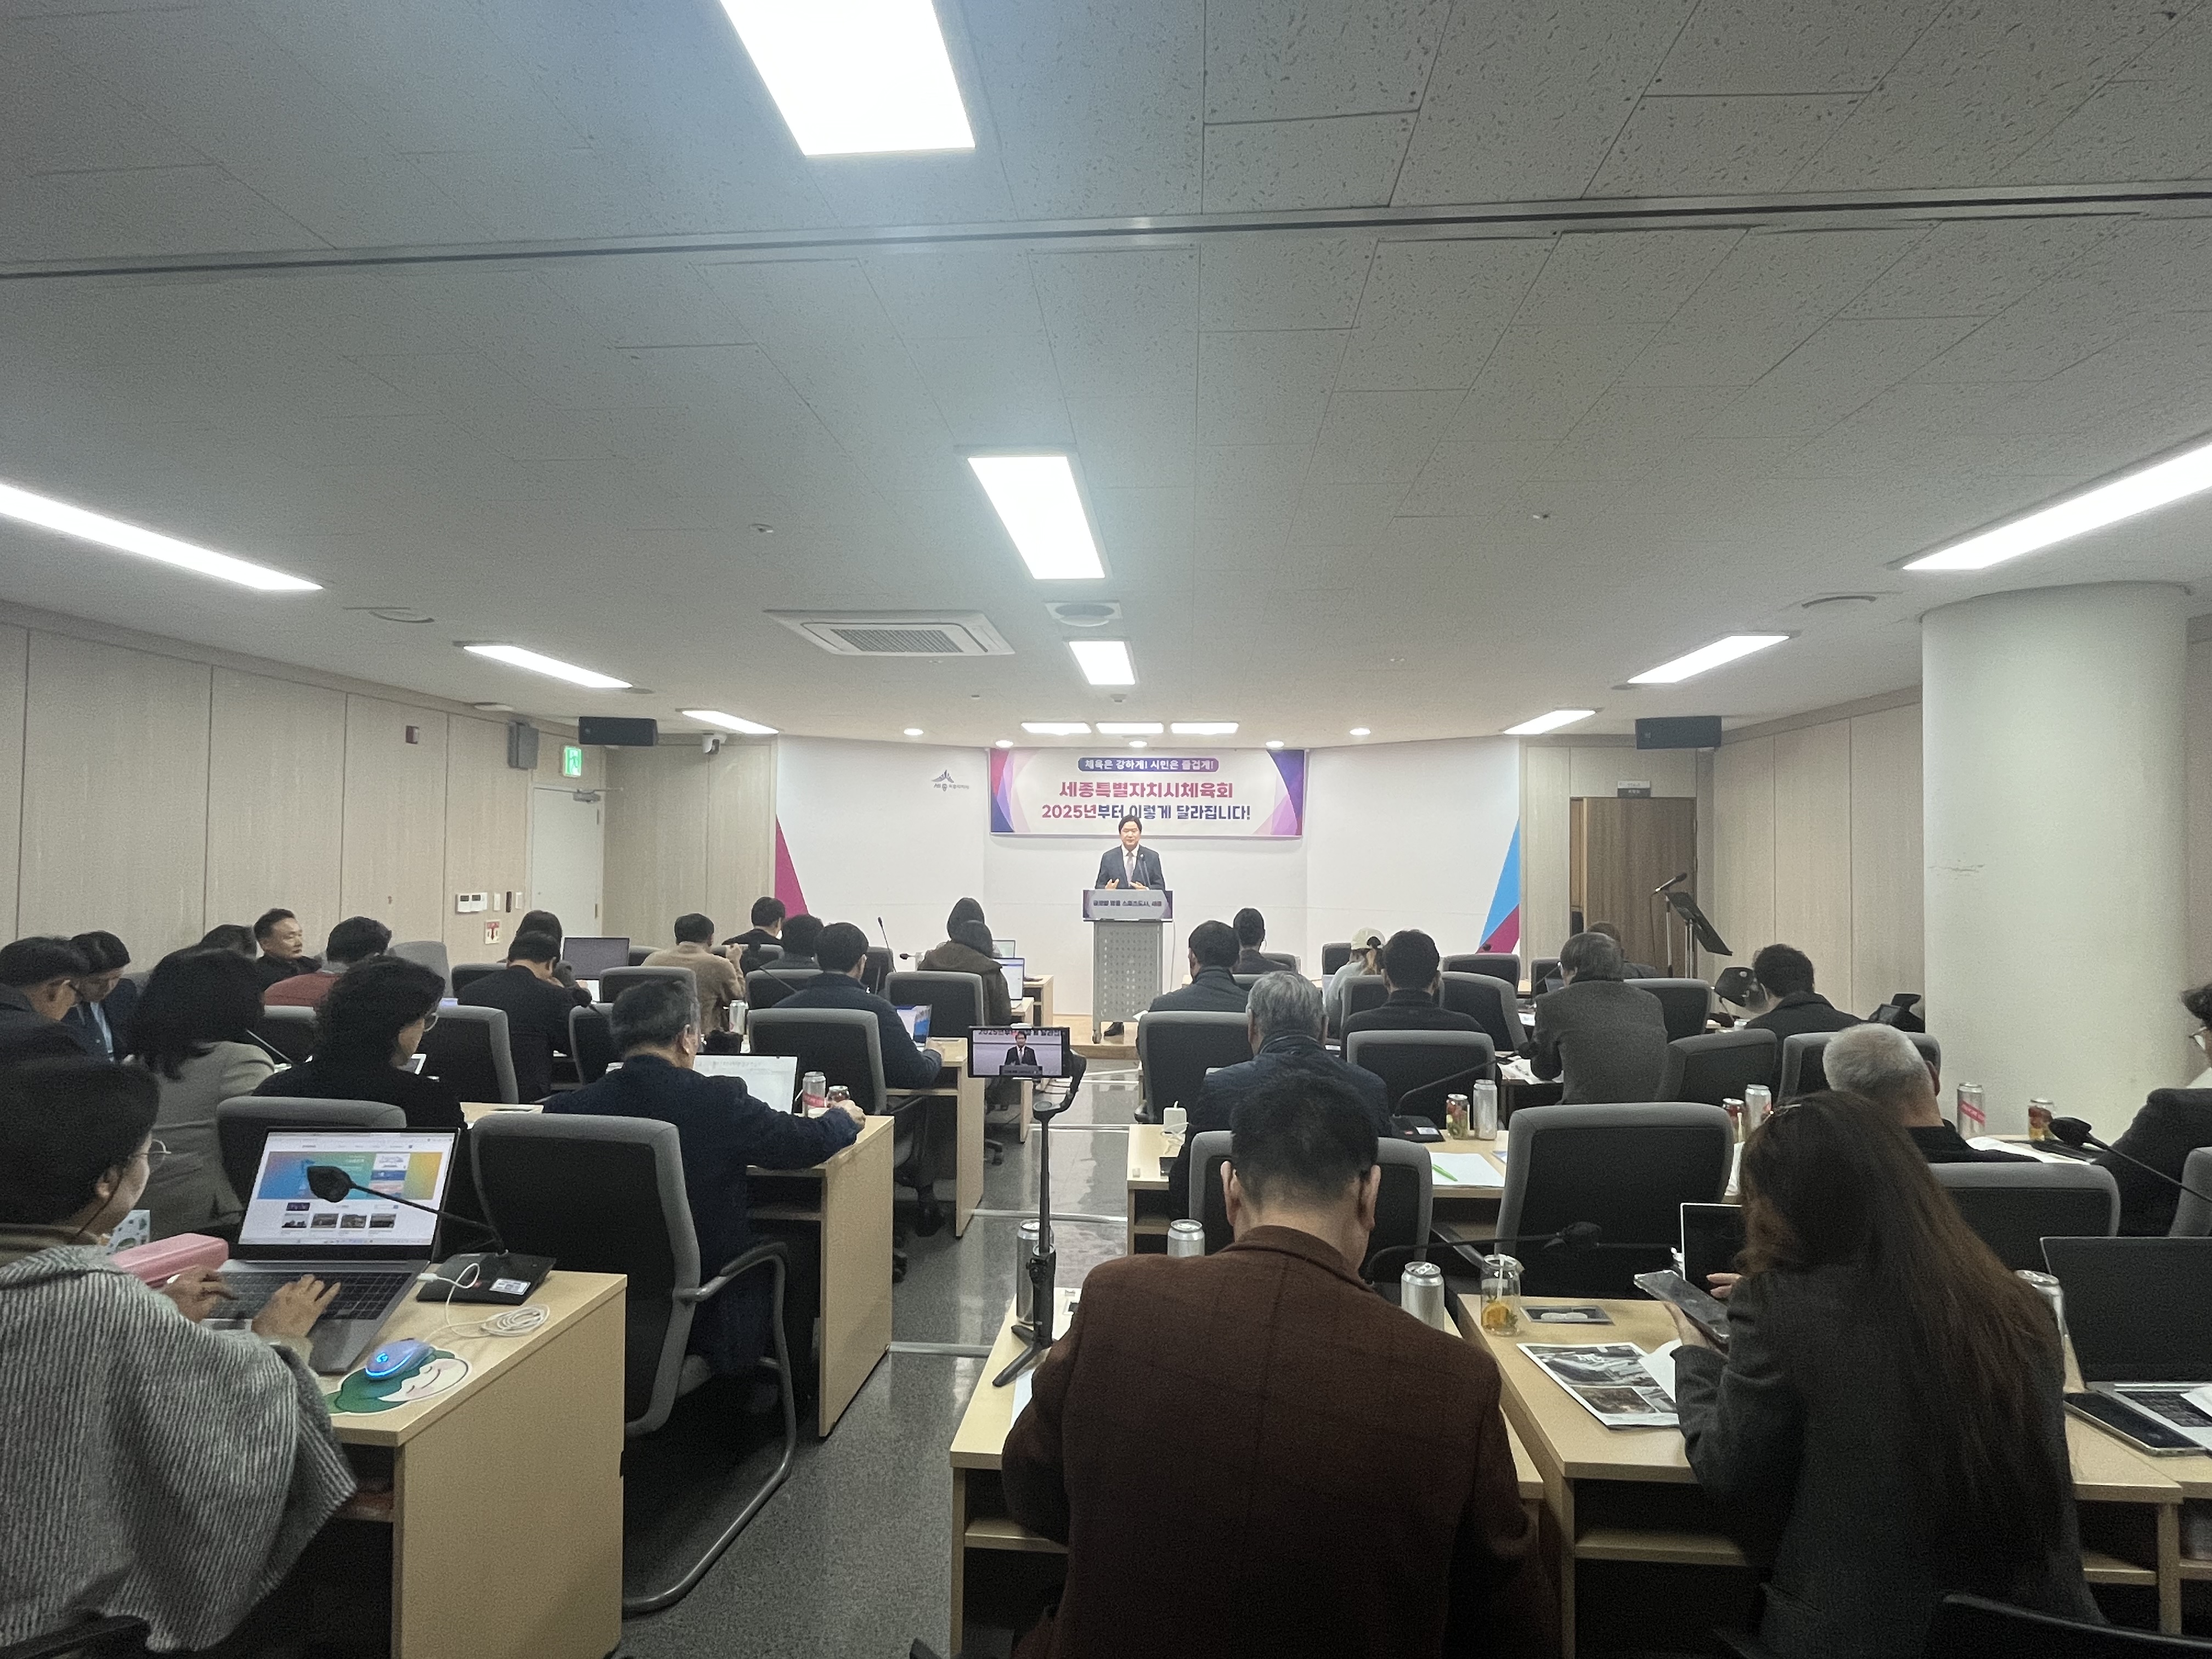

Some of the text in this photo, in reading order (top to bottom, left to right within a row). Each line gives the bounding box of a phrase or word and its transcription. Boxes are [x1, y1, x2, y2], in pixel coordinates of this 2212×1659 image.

[1085, 759, 1114, 770] 체육은
[1115, 759, 1148, 770] 강하게!
[1150, 759, 1178, 770] 시민은
[1059, 782, 1233, 798] 세종특별자치시체육회
[1042, 804, 1251, 820] 2025년부터 이렇게 달라집니다!
